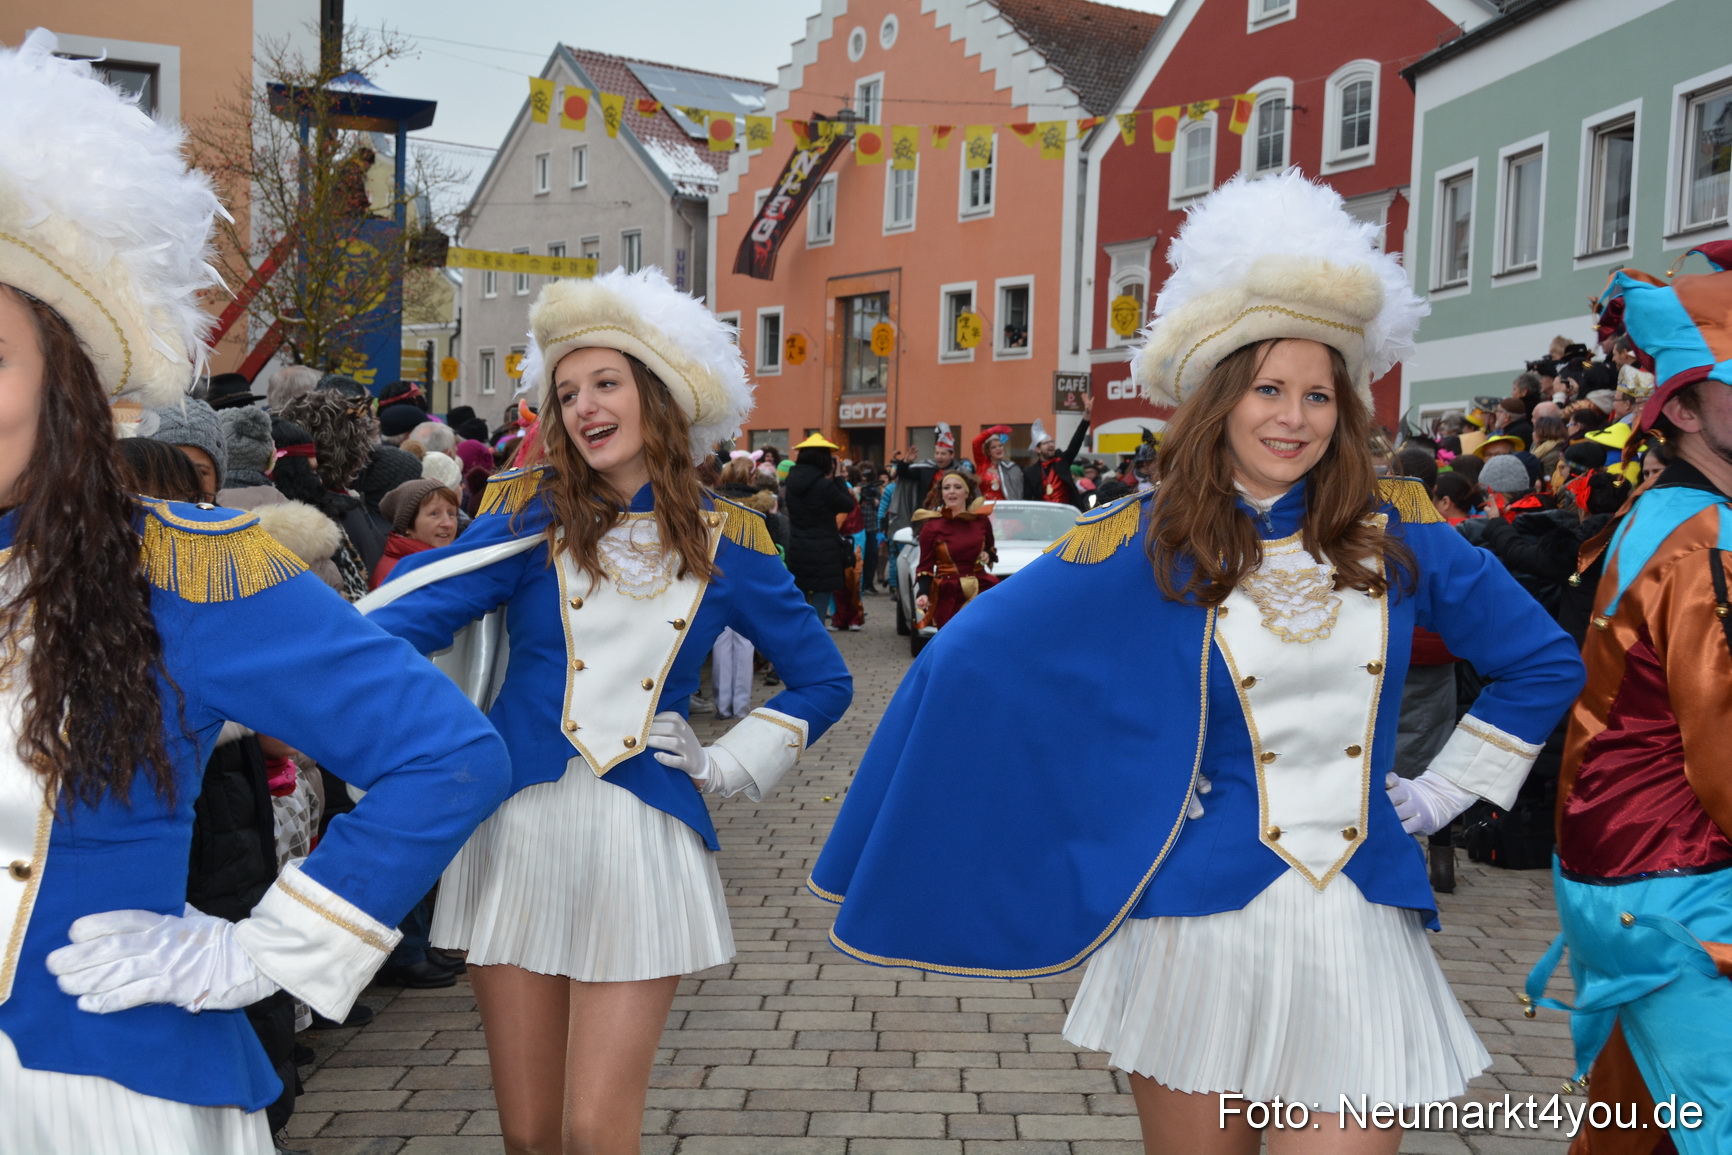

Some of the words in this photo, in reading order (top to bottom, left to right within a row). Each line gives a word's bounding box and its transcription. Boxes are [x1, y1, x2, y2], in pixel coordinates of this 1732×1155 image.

[676, 249, 686, 293] UHR
[1057, 376, 1086, 392] CAFÉ
[1107, 377, 1149, 400] GÖ
[839, 402, 887, 420] GÖTZ
